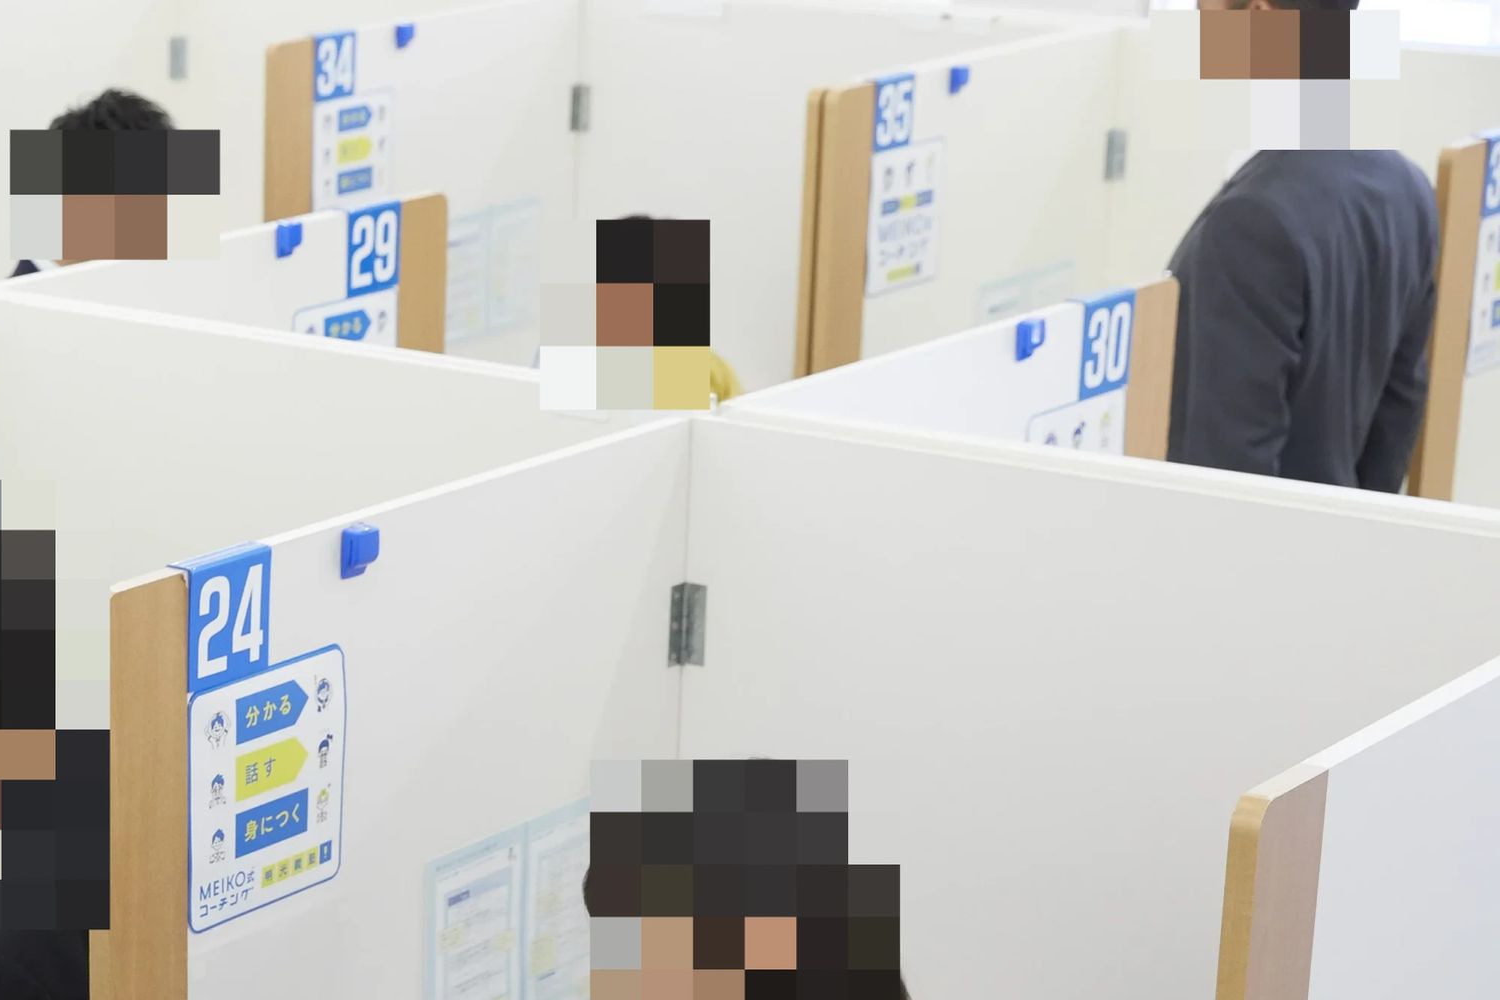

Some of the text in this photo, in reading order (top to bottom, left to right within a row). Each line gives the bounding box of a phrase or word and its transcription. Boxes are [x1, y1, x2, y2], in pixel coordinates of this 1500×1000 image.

[316, 35, 354, 98] 34
[875, 78, 913, 148] 35
[351, 209, 397, 290] 29
[1084, 301, 1132, 390] 30
[197, 563, 264, 680] 24
[245, 694, 292, 729] 分かる
[245, 757, 277, 786] 話す
[244, 803, 301, 843] 身につく
[199, 868, 256, 902] MEIKO式
[199, 886, 255, 918] コーチング
